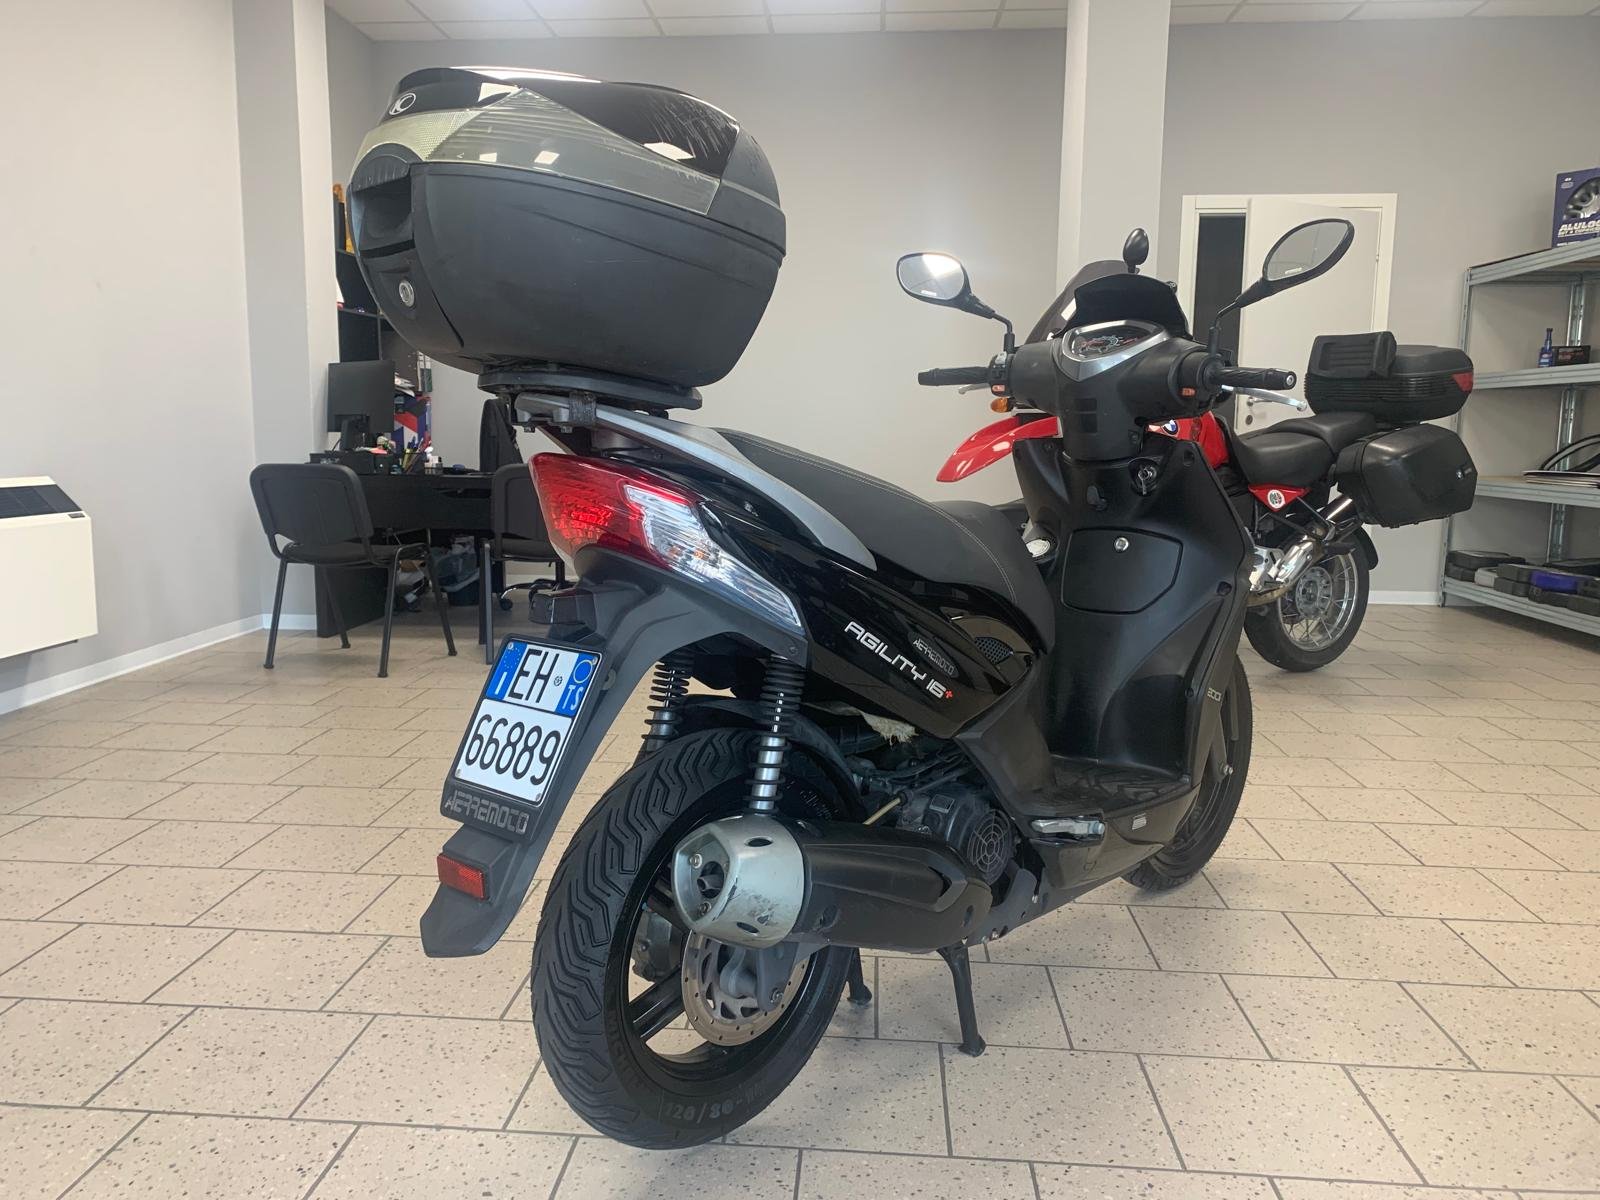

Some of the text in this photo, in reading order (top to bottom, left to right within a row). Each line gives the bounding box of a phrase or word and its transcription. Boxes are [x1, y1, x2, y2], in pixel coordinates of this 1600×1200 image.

[507, 648, 560, 703] EH
[844, 621, 927, 681] AGILITY
[562, 684, 584, 711] TS
[465, 713, 561, 786] 66889
